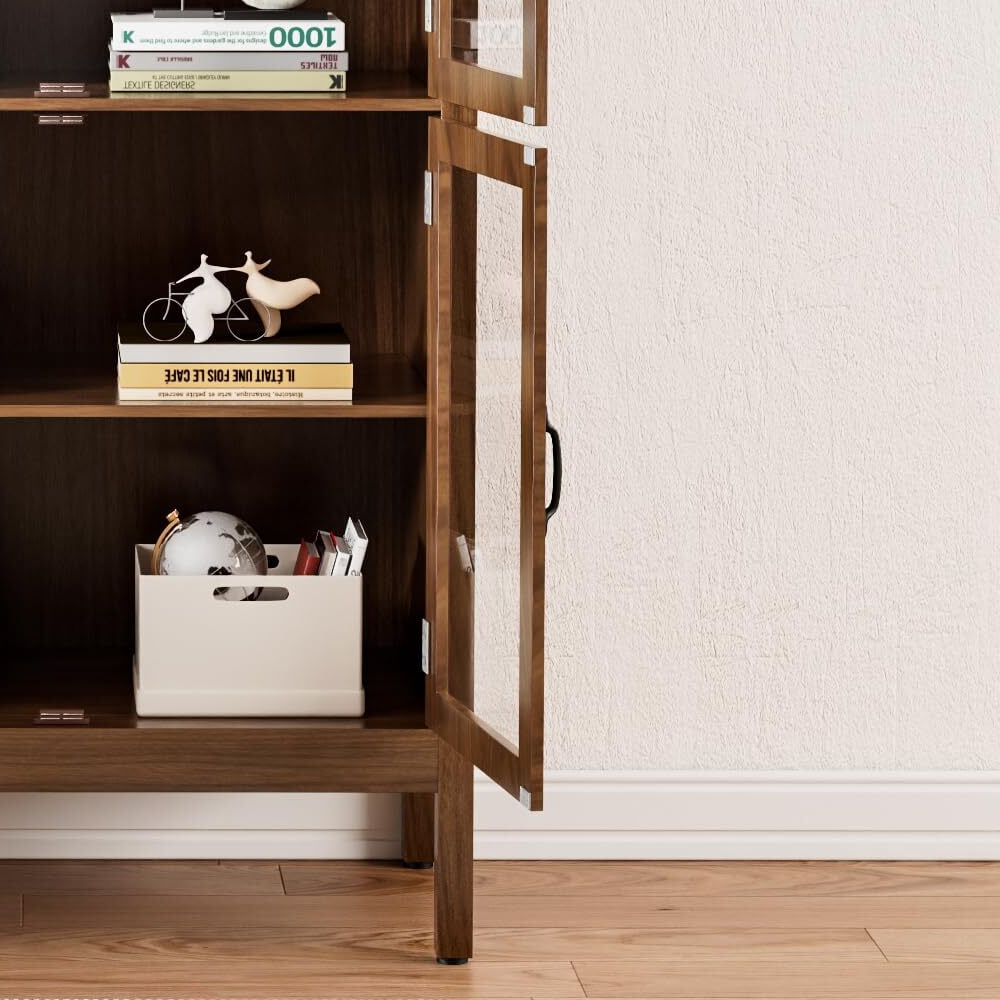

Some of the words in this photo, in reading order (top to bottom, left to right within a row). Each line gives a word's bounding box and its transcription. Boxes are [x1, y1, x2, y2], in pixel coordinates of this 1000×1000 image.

[123, 31, 134, 44] K
[269, 27, 337, 48] 1000
[116, 55, 130, 68] K
[164, 369, 191, 384] CAFÉ
[193, 369, 205, 382] LE
[207, 369, 230, 382] FOIS
[232, 369, 253, 382] UNE
[256, 369, 283, 384] ÉTAIT
[285, 369, 296, 382] IL
